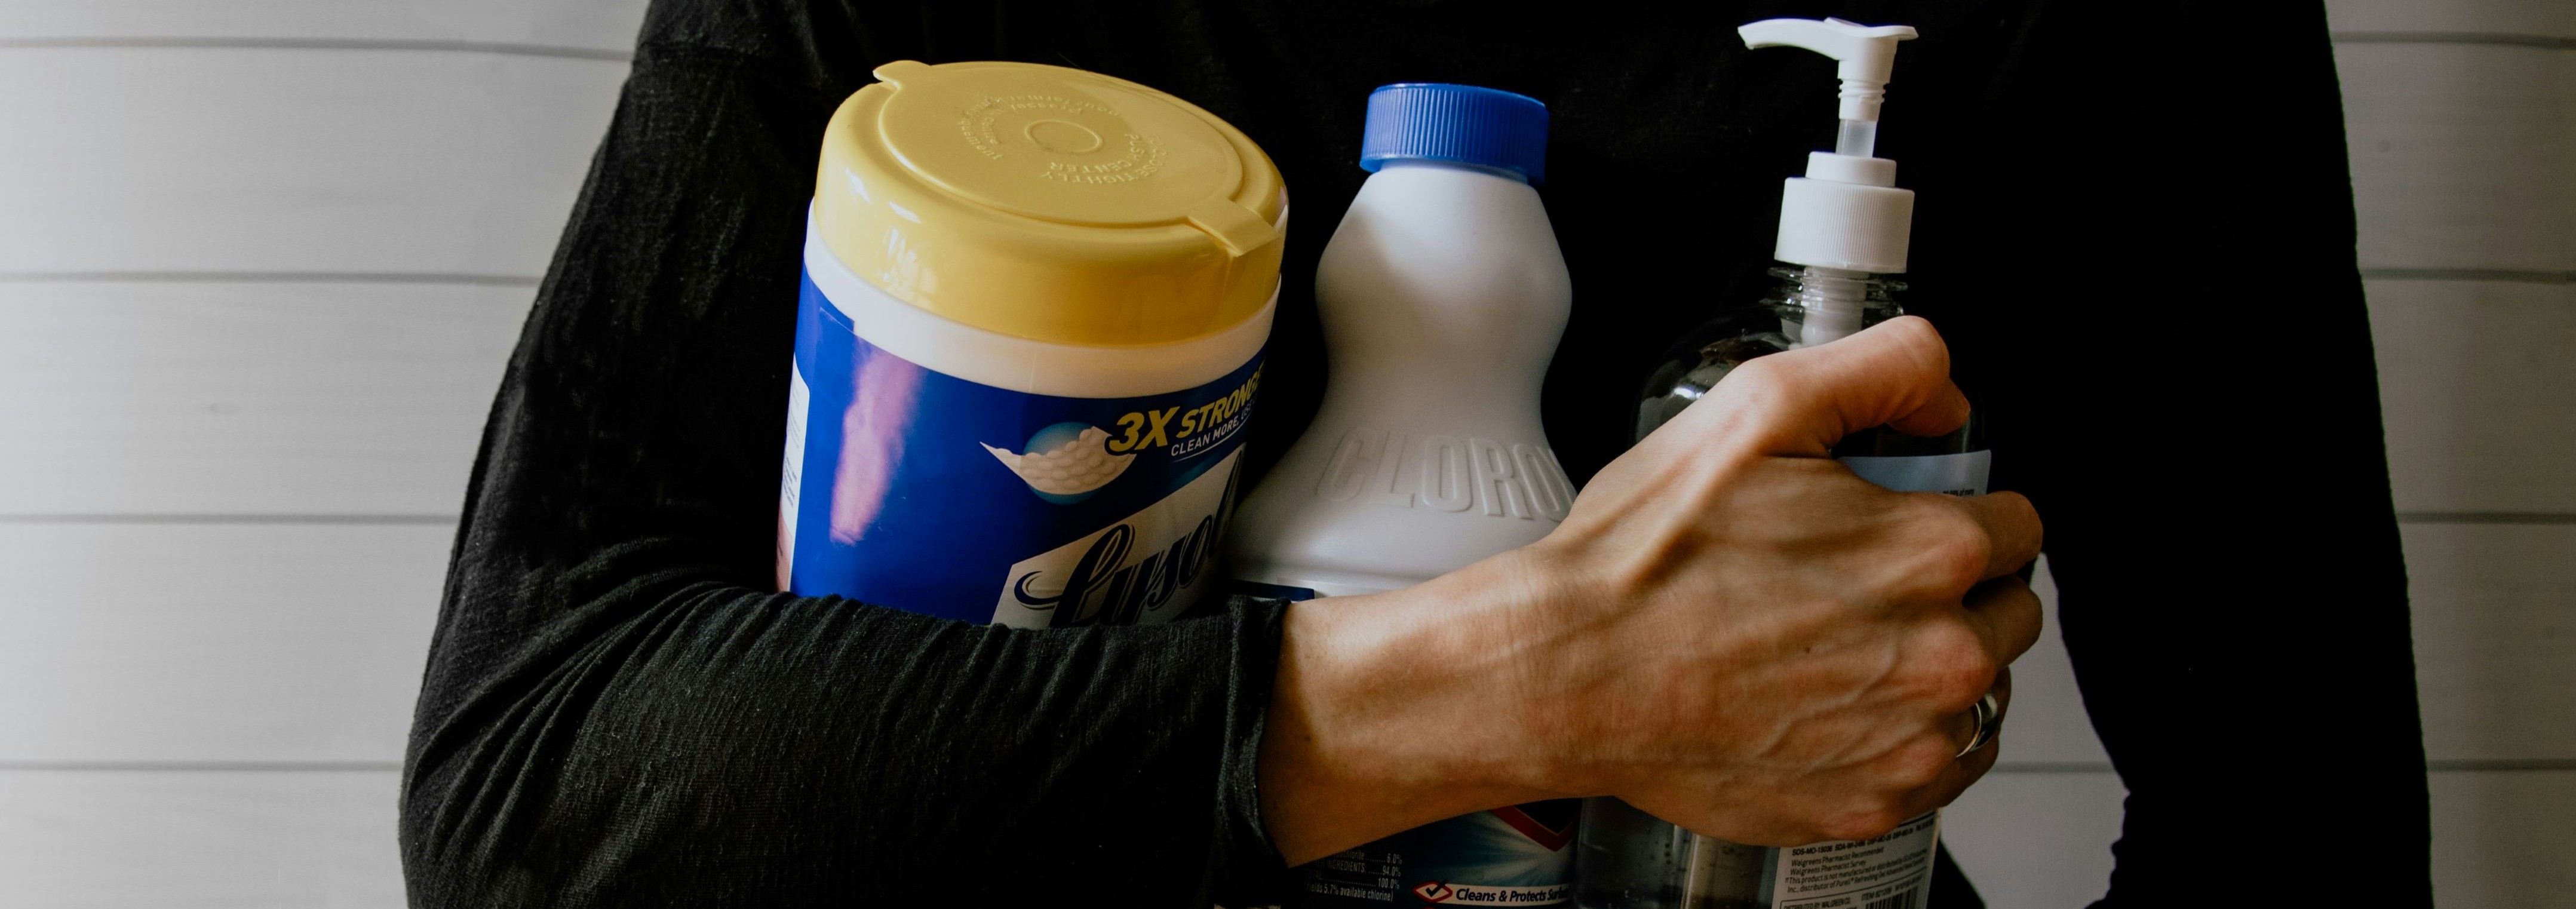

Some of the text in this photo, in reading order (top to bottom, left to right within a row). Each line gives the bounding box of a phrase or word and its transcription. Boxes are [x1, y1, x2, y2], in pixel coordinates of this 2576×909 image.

[1049, 133, 1144, 172] PUSH CENTER
[1135, 148, 1168, 177] CLOSE
[1041, 171, 1138, 185] TIGHTLY
[1109, 357, 1264, 453] 3X STRONG
[1171, 432, 1211, 457] CLEAN
[1212, 415, 1240, 441] MORE,
[1315, 426, 1578, 524] CLORO
[1014, 449, 1244, 627] Lysol
[1387, 853, 1402, 865] 6.0%
[1792, 858, 1822, 868] Walgreens
[1822, 854, 1850, 863] Pharmacist
[1382, 865, 1401, 877] 94.0%
[1791, 867, 1820, 877] Walgreens
[1820, 862, 1850, 871] Pharmacist
[1378, 878, 1400, 890] 100.0%
[1801, 876, 1823, 885] product
[1324, 884, 1339, 895] 5.7%
[1340, 886, 1367, 899] available
[1367, 890, 1394, 902] chlorine)
[1456, 888, 1496, 902] Cleans
[1499, 890, 1507, 902] &
[1510, 890, 1547, 902] Protects
[1800, 884, 1829, 893] distributor
